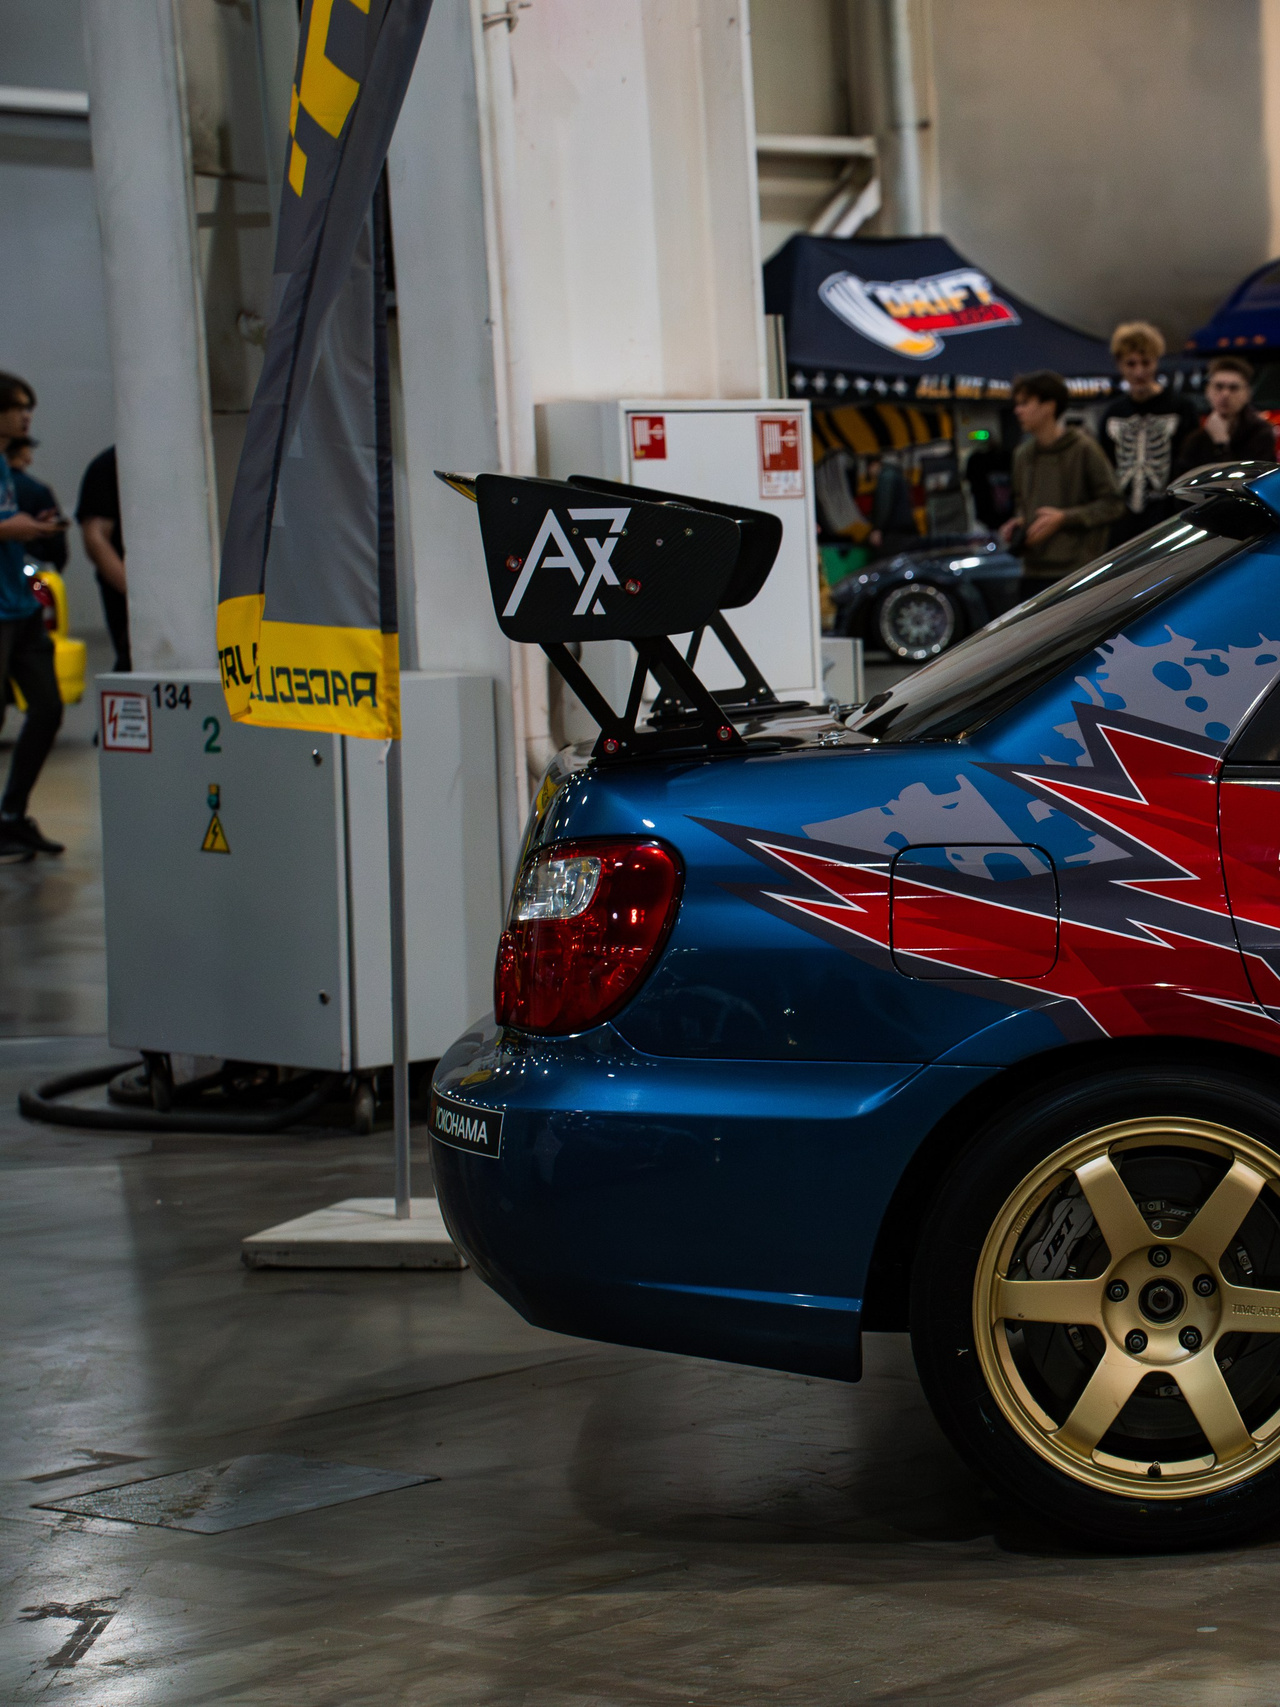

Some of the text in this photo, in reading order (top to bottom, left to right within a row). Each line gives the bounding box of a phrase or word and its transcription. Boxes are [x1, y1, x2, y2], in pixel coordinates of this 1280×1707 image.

[153, 683, 191, 709] 134
[203, 716, 222, 753] 2
[436, 1106, 488, 1145] YOKOHAMA
[1042, 1207, 1073, 1273] JBT
